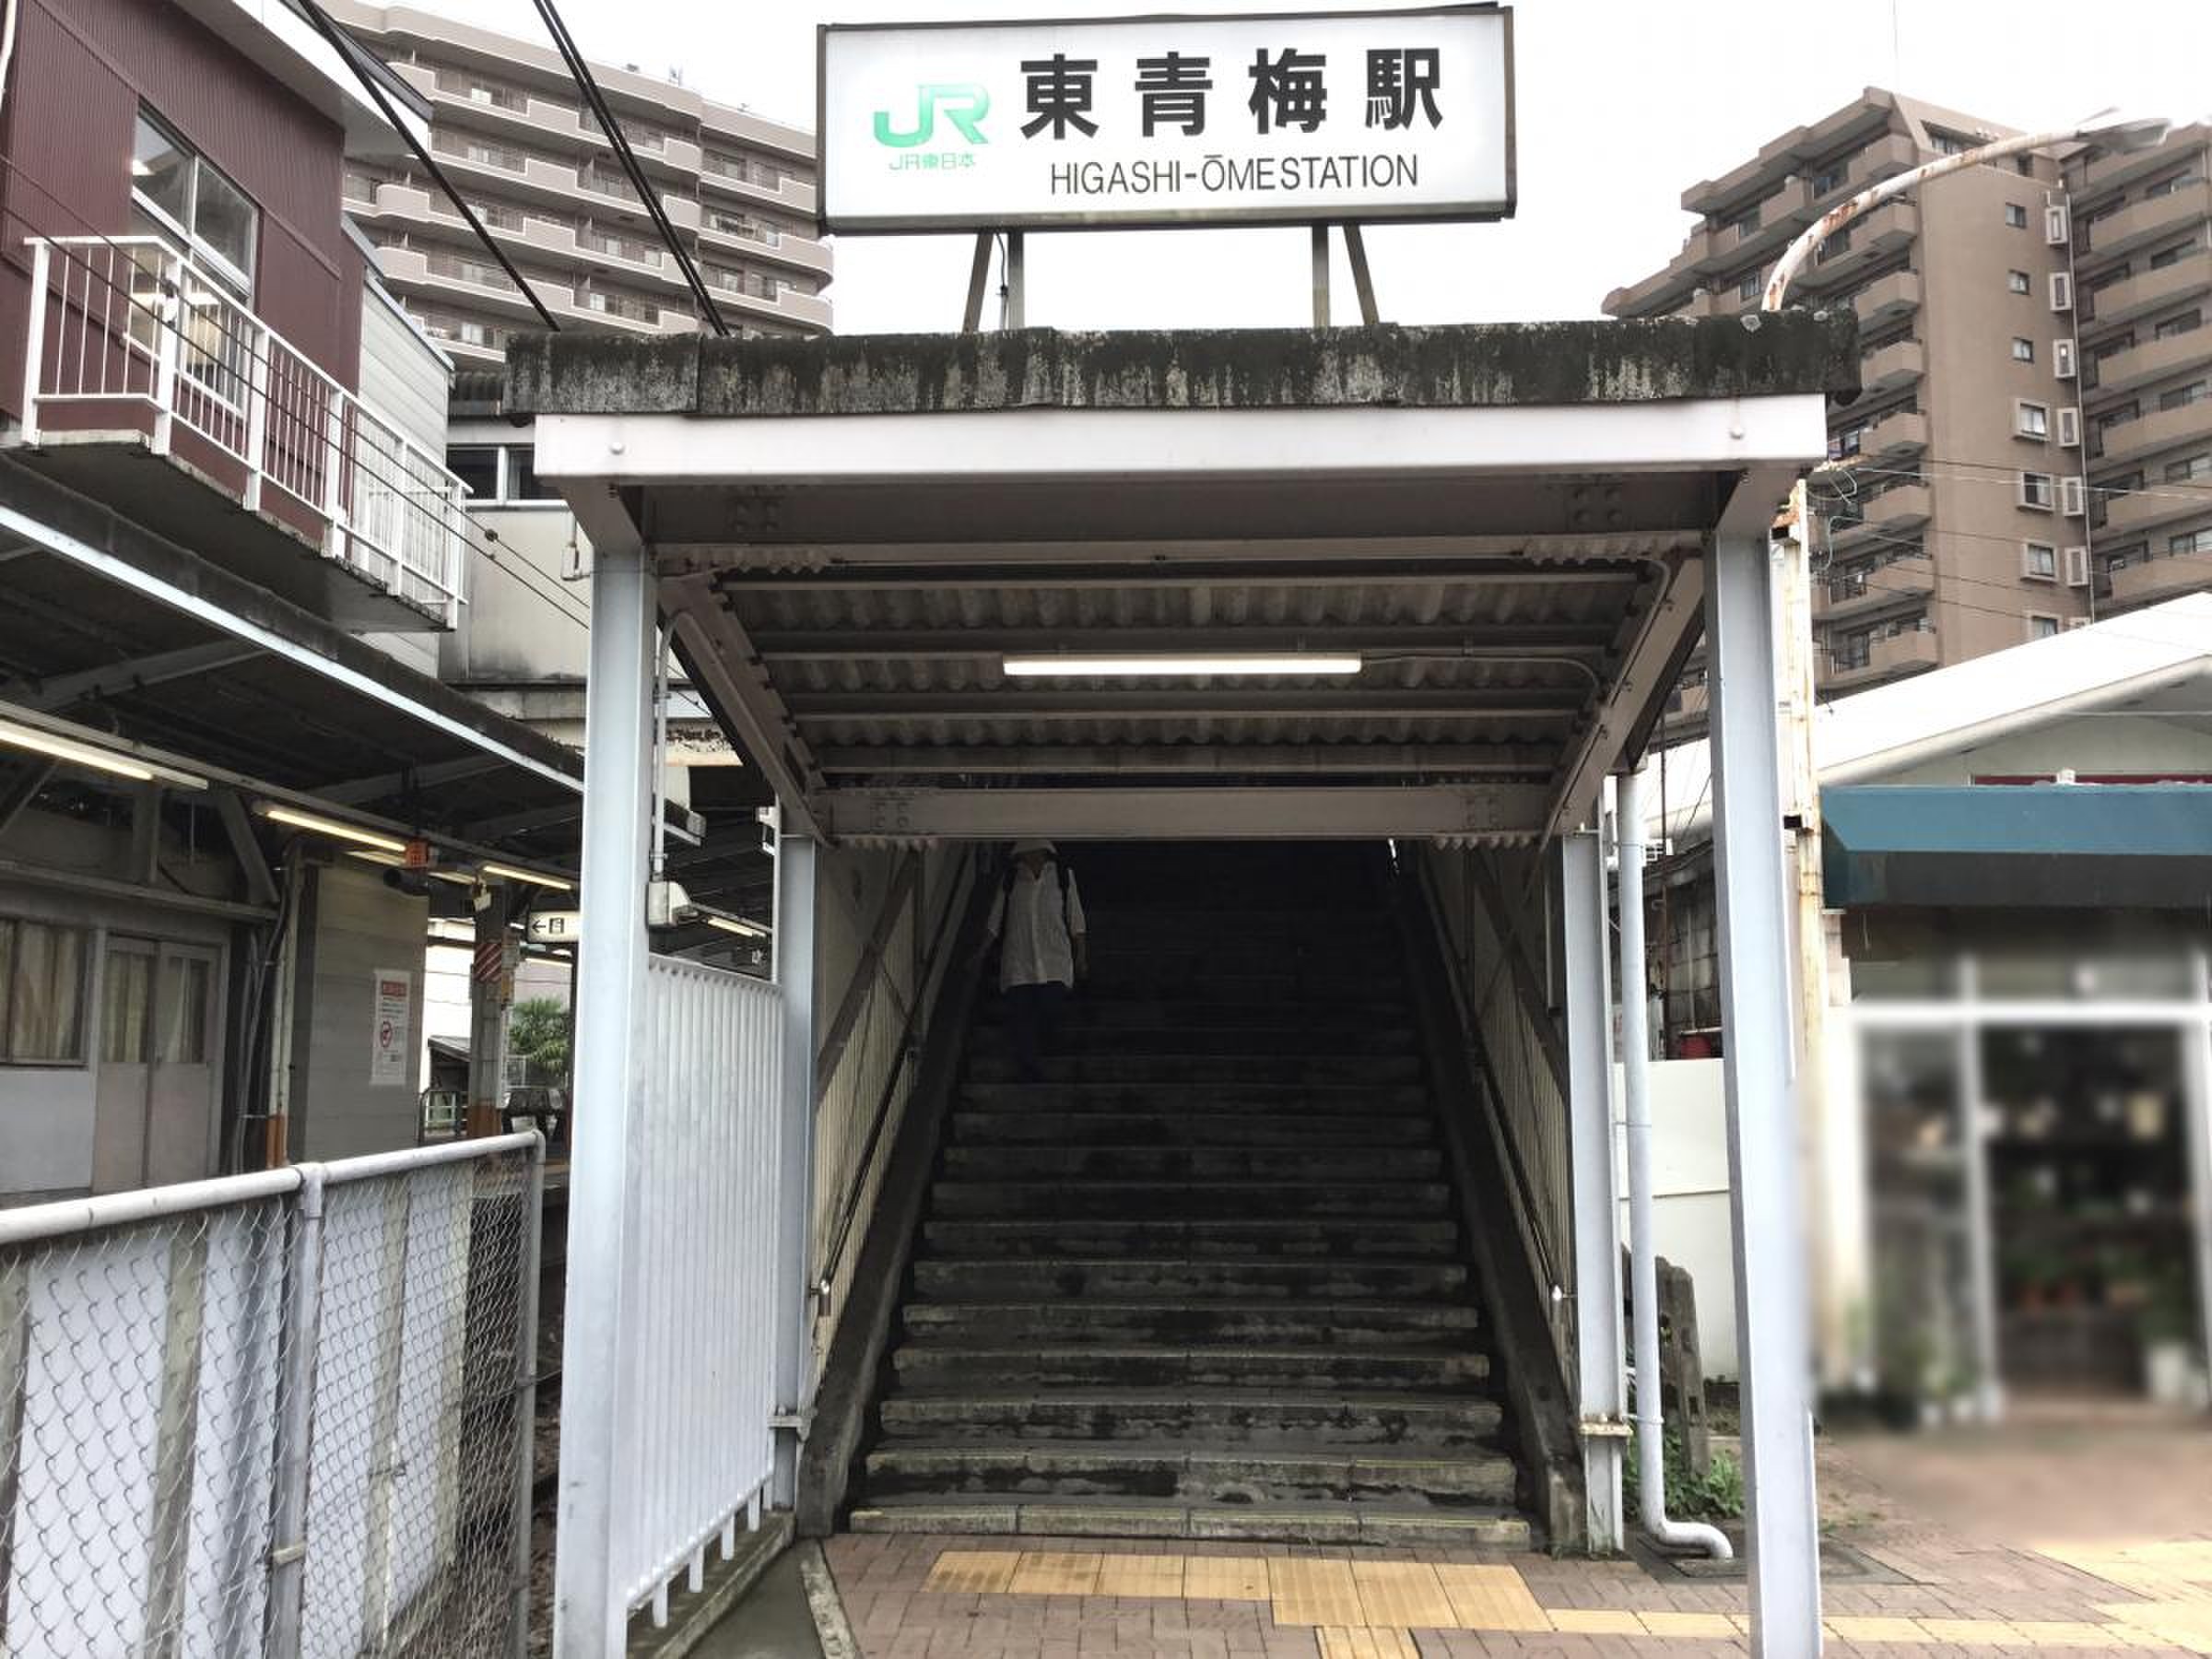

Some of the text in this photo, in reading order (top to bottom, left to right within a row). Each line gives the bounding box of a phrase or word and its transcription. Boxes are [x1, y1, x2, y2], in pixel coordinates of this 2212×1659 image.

[873, 84, 990, 147] JR
[1020, 48, 1443, 139] 東青梅駅
